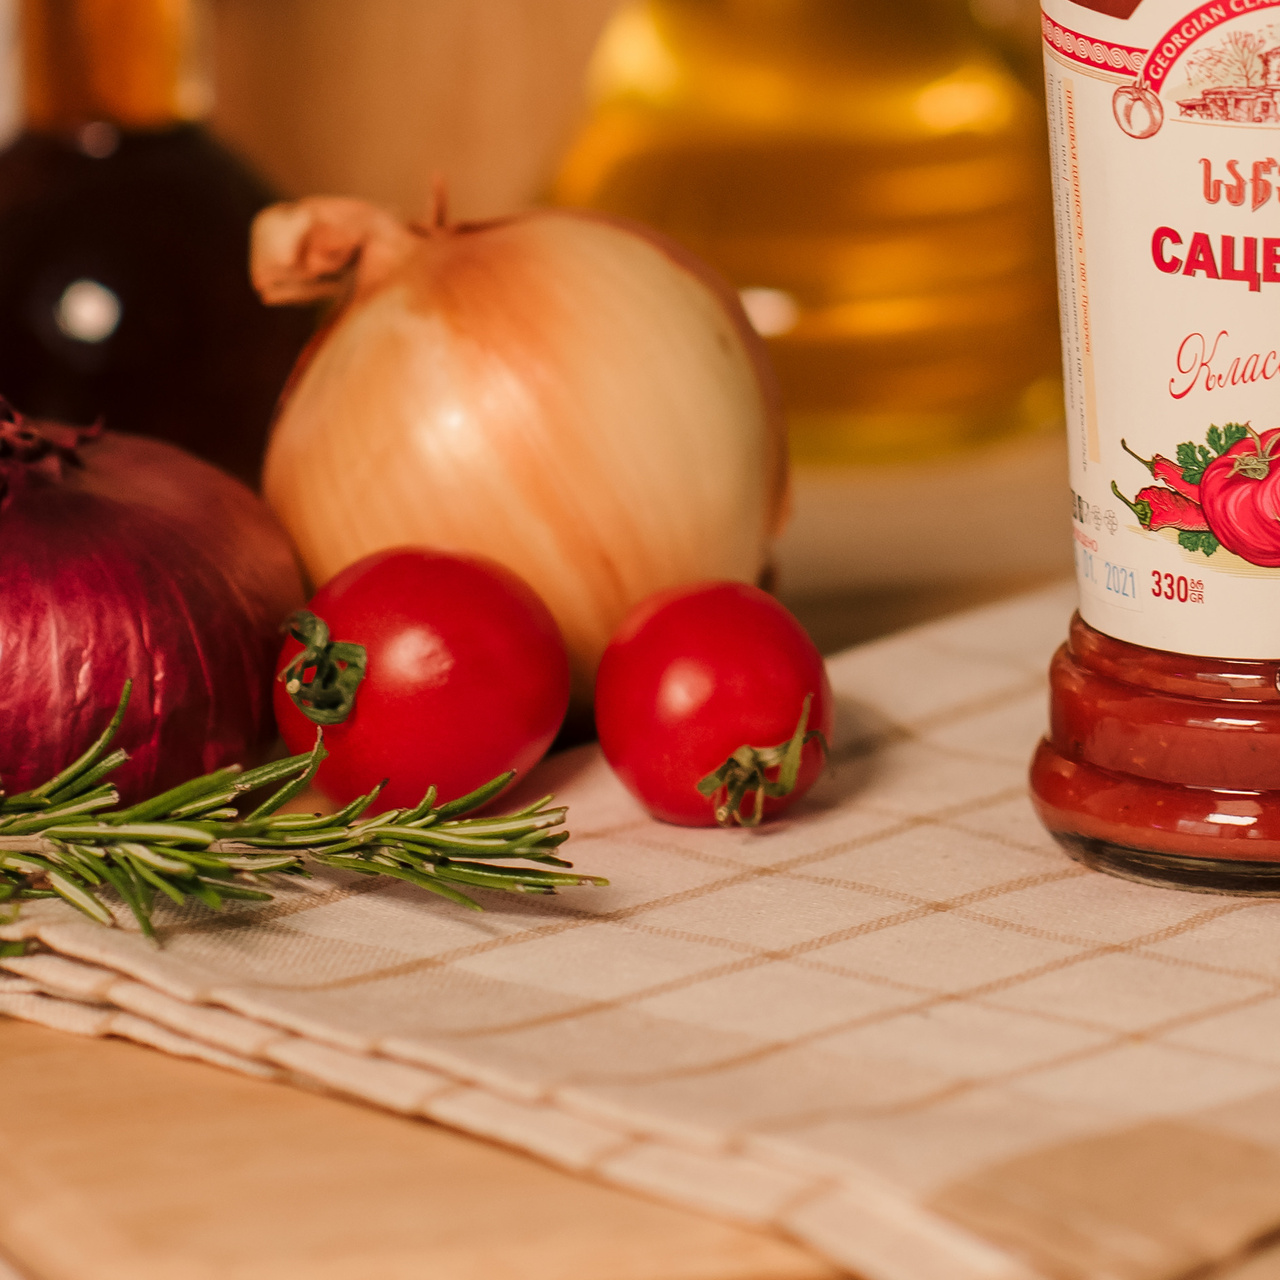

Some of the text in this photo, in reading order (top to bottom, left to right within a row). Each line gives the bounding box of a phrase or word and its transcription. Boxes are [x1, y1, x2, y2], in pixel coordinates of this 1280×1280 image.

[1149, 4, 1227, 80] GEORGIAN
[1065, 89, 1078, 160] ПИЩЕВАЯ
[1072, 164, 1083, 240] ЦЕННОСТЬ
[1104, 561, 1136, 599] 2021
[1151, 569, 1189, 603] 330
[1189, 592, 1205, 605] GR
